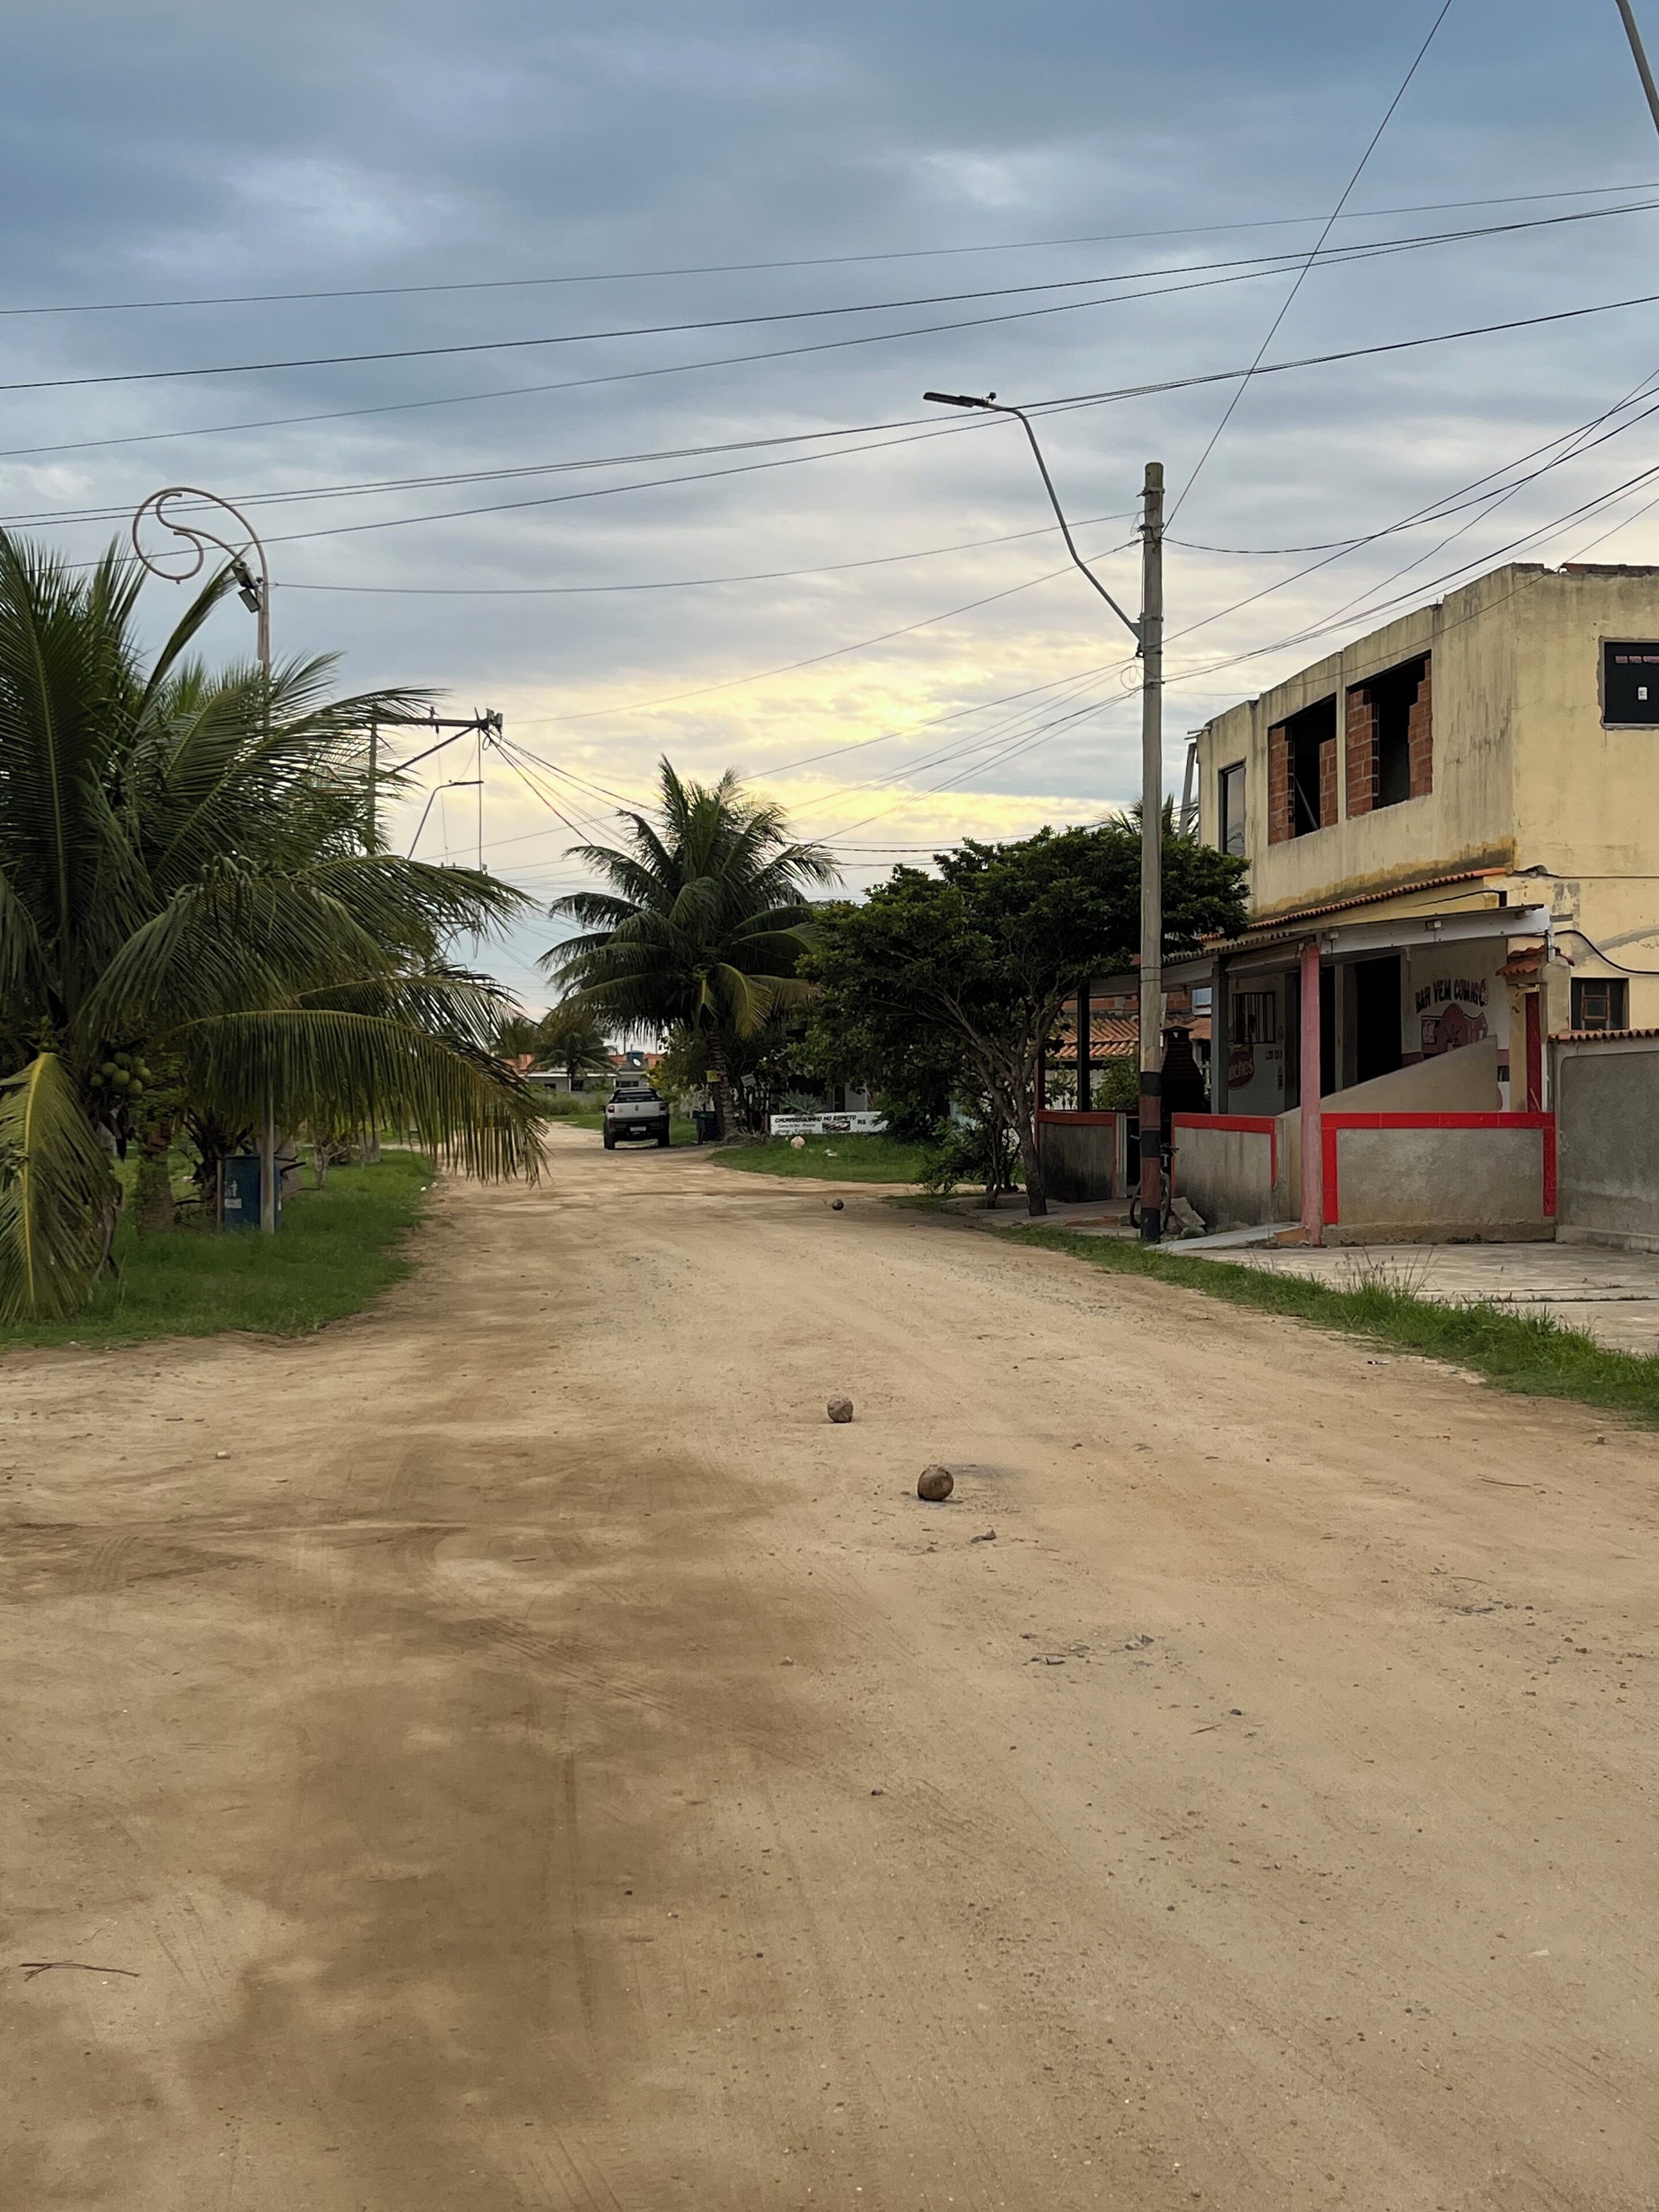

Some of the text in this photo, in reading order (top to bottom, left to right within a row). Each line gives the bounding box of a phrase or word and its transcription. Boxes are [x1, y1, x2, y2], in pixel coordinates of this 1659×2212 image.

[1415, 986, 1431, 1014] BAR
[1433, 979, 1452, 1003] VEM
[1228, 1058, 1254, 1081] nches
